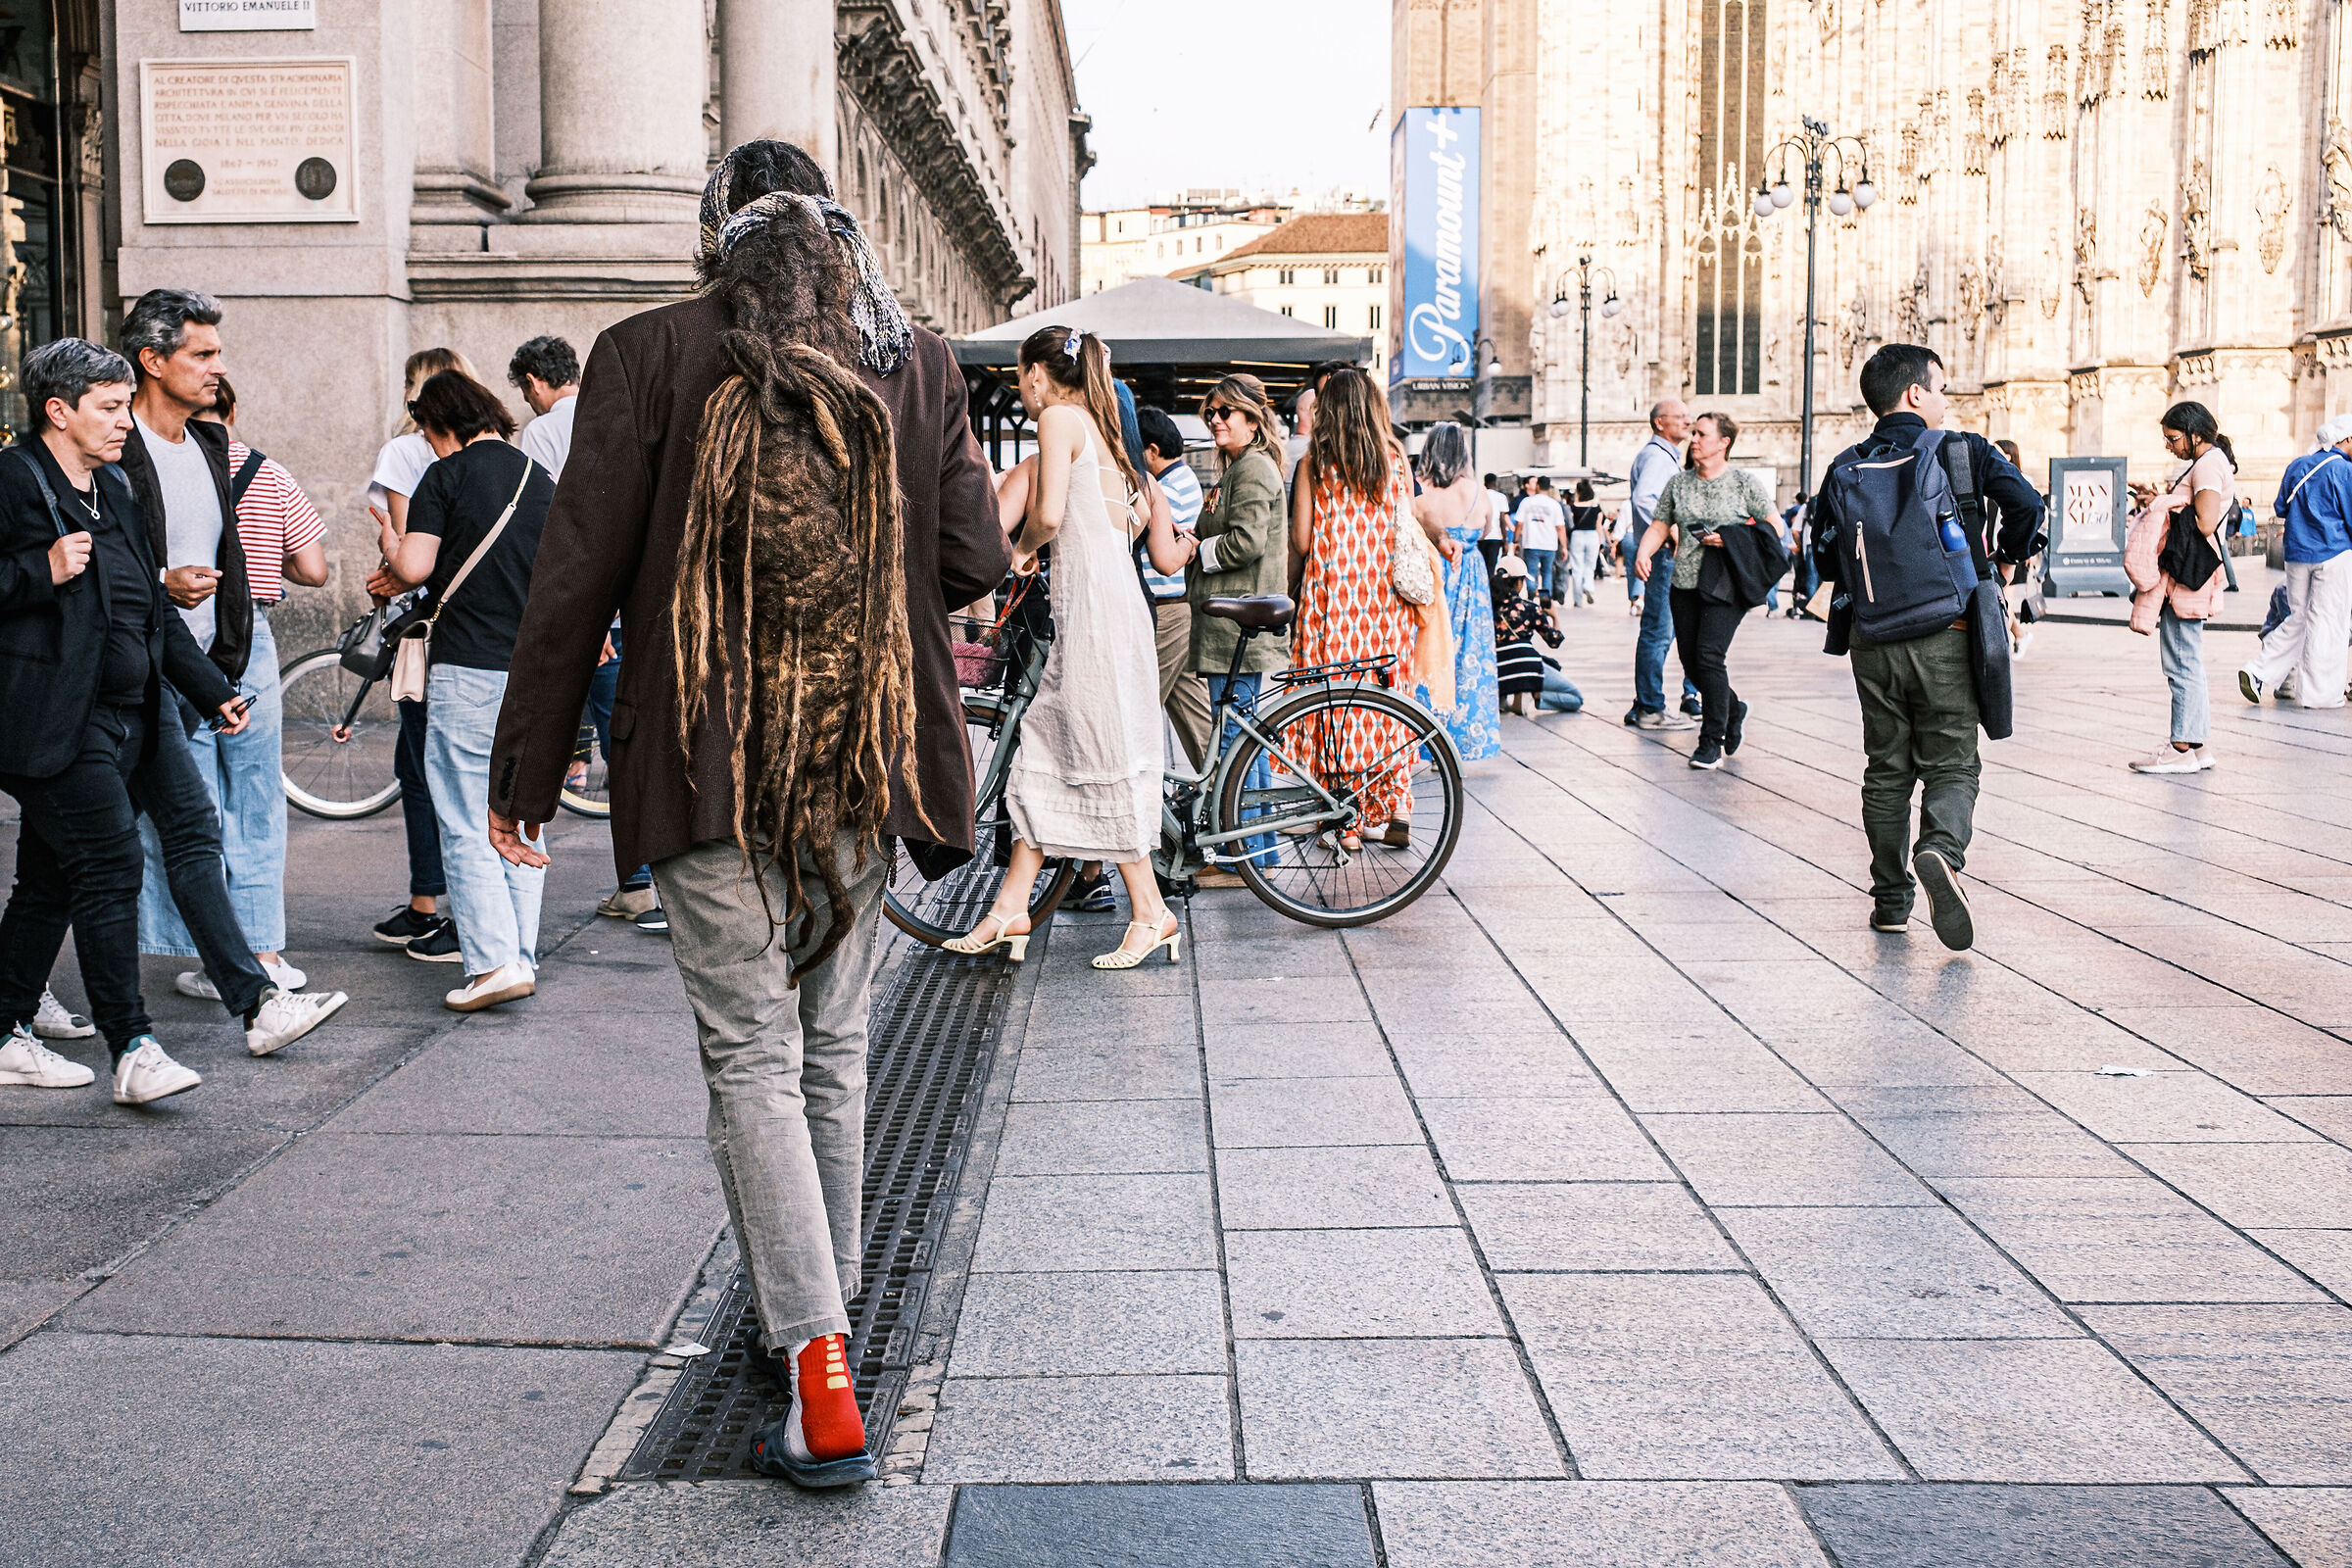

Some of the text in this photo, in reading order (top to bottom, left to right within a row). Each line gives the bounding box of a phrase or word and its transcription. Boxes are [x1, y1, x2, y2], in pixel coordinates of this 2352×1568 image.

[184, 1, 310, 12] VITTORIO EMANUELE II
[154, 74, 342, 85] AL CREATORE DI QVESTA STRAORDINARIA
[155, 88, 224, 97] ARCHITETTVRA
[279, 85, 341, 95] FELICEMENTE
[154, 101, 218, 110] RISPECCHIATA
[313, 99, 343, 108] DELLA
[215, 113, 252, 122] MILANO
[256, 112, 271, 121] PER
[292, 112, 328, 121] SECOLO
[330, 111, 343, 120] HA
[155, 138, 187, 147] NELLA
[191, 138, 220, 147] GIOIA
[305, 136, 344, 146] DEDICA
[1409, 113, 1470, 363] Paramount+
[1412, 381, 1470, 391] URBAN VISION
